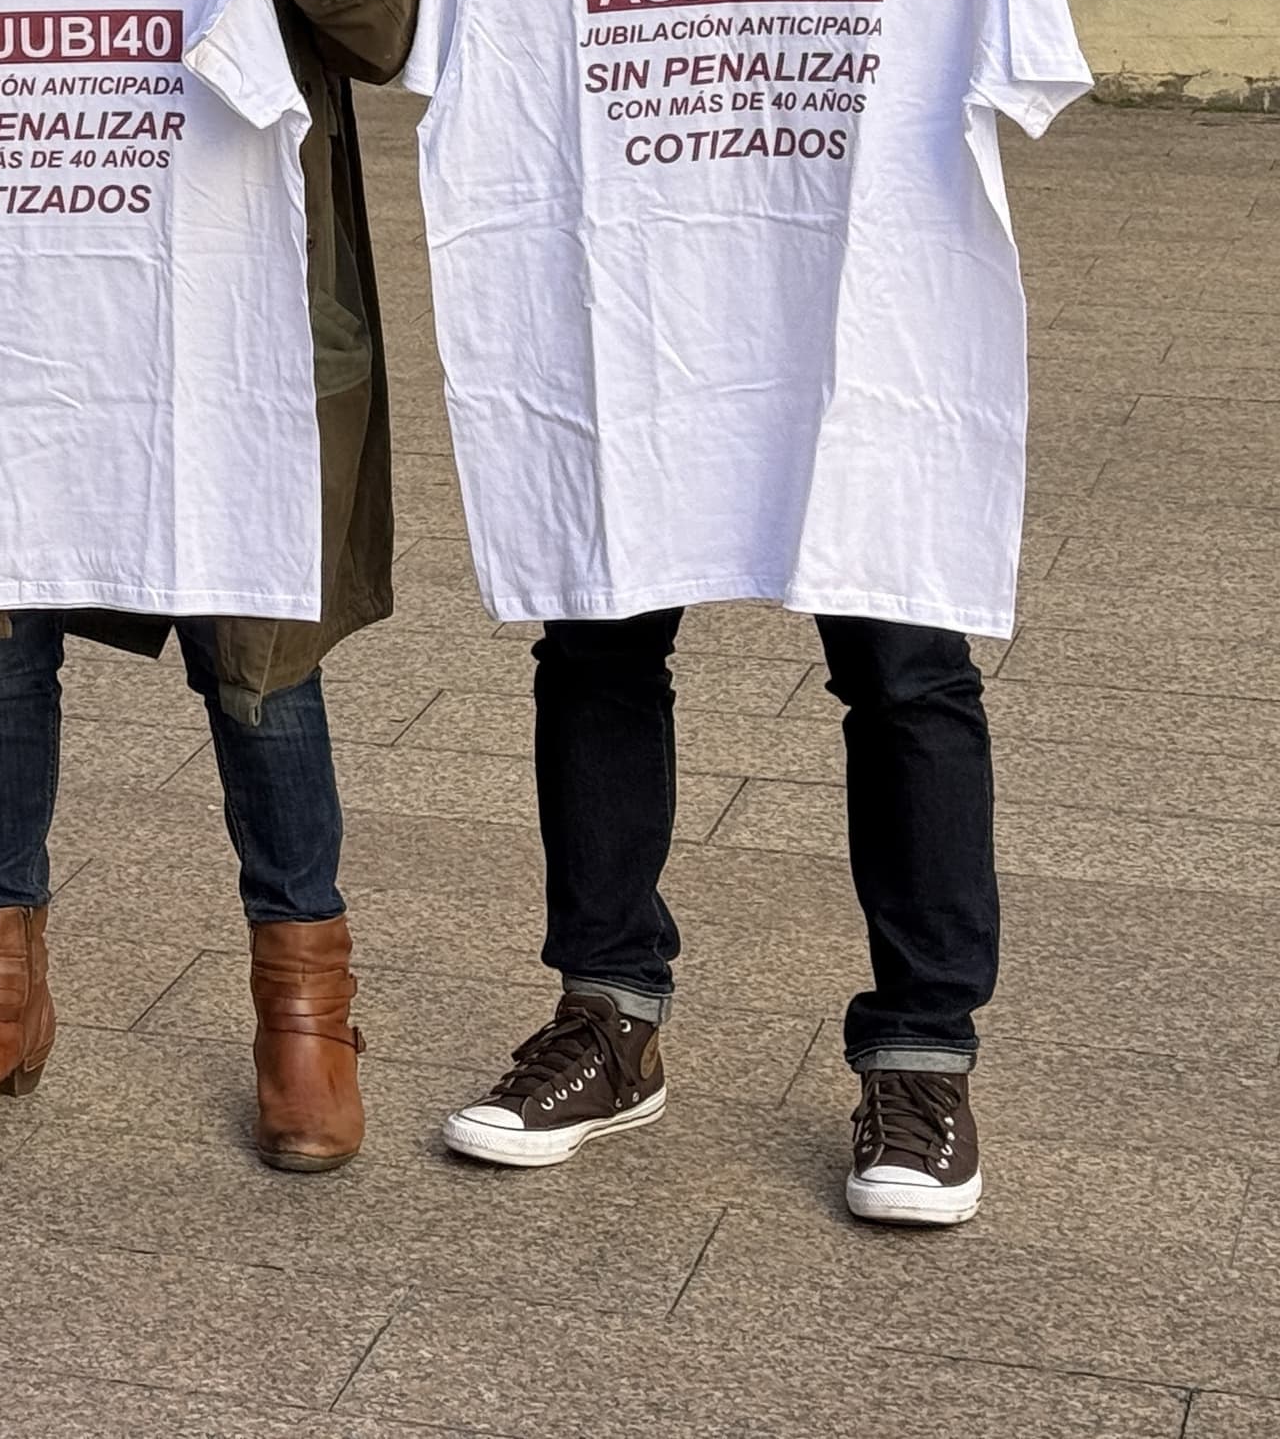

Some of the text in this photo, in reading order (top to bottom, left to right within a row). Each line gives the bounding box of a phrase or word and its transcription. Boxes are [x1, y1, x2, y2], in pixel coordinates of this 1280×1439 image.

[580, 14, 882, 47] JUBILACIÓN ANTICIPADA
[42, 76, 184, 96] ANTICIPADA
[585, 52, 880, 93] SIN PENALIZAR
[607, 88, 867, 120] CON MÁS DE 40 AÑOS
[31, 150, 64, 168] DE
[70, 149, 96, 168] 40
[102, 145, 170, 168] AÑOS
[625, 127, 847, 166] COTIZADOS
